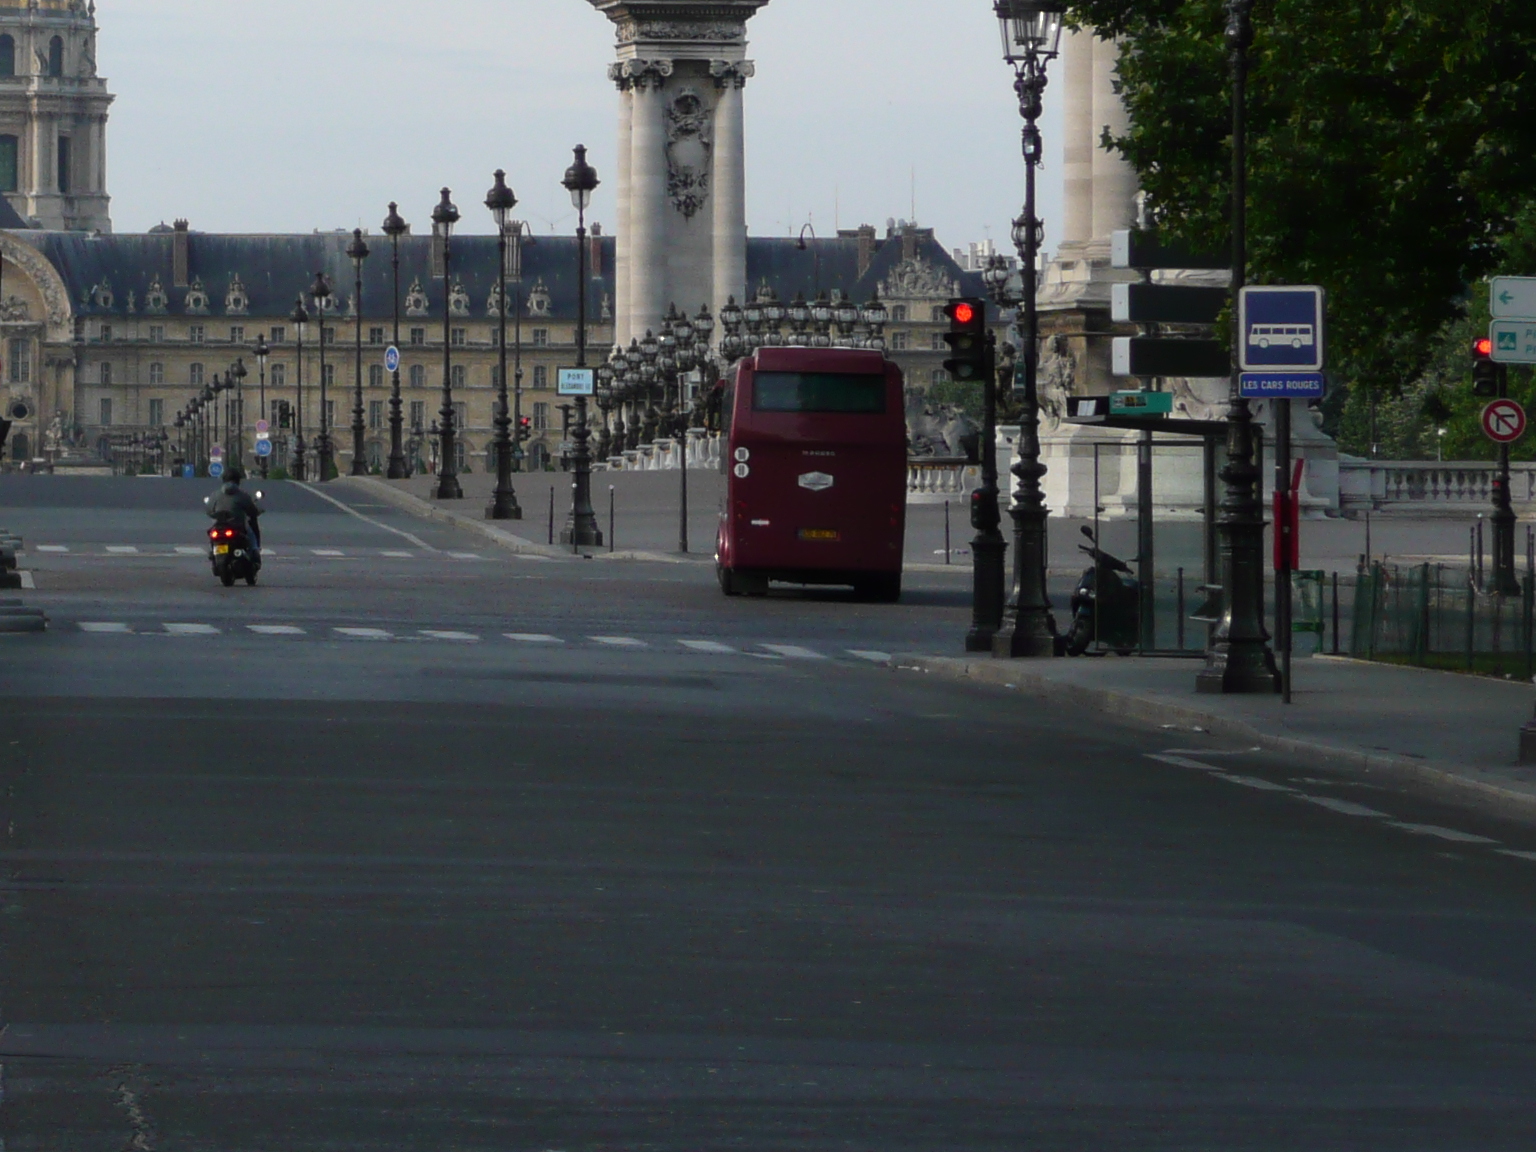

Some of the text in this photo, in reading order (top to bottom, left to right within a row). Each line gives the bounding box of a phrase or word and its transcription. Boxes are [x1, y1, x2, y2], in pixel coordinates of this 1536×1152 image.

[1243, 380, 1320, 390] LES CARS ROUGES
